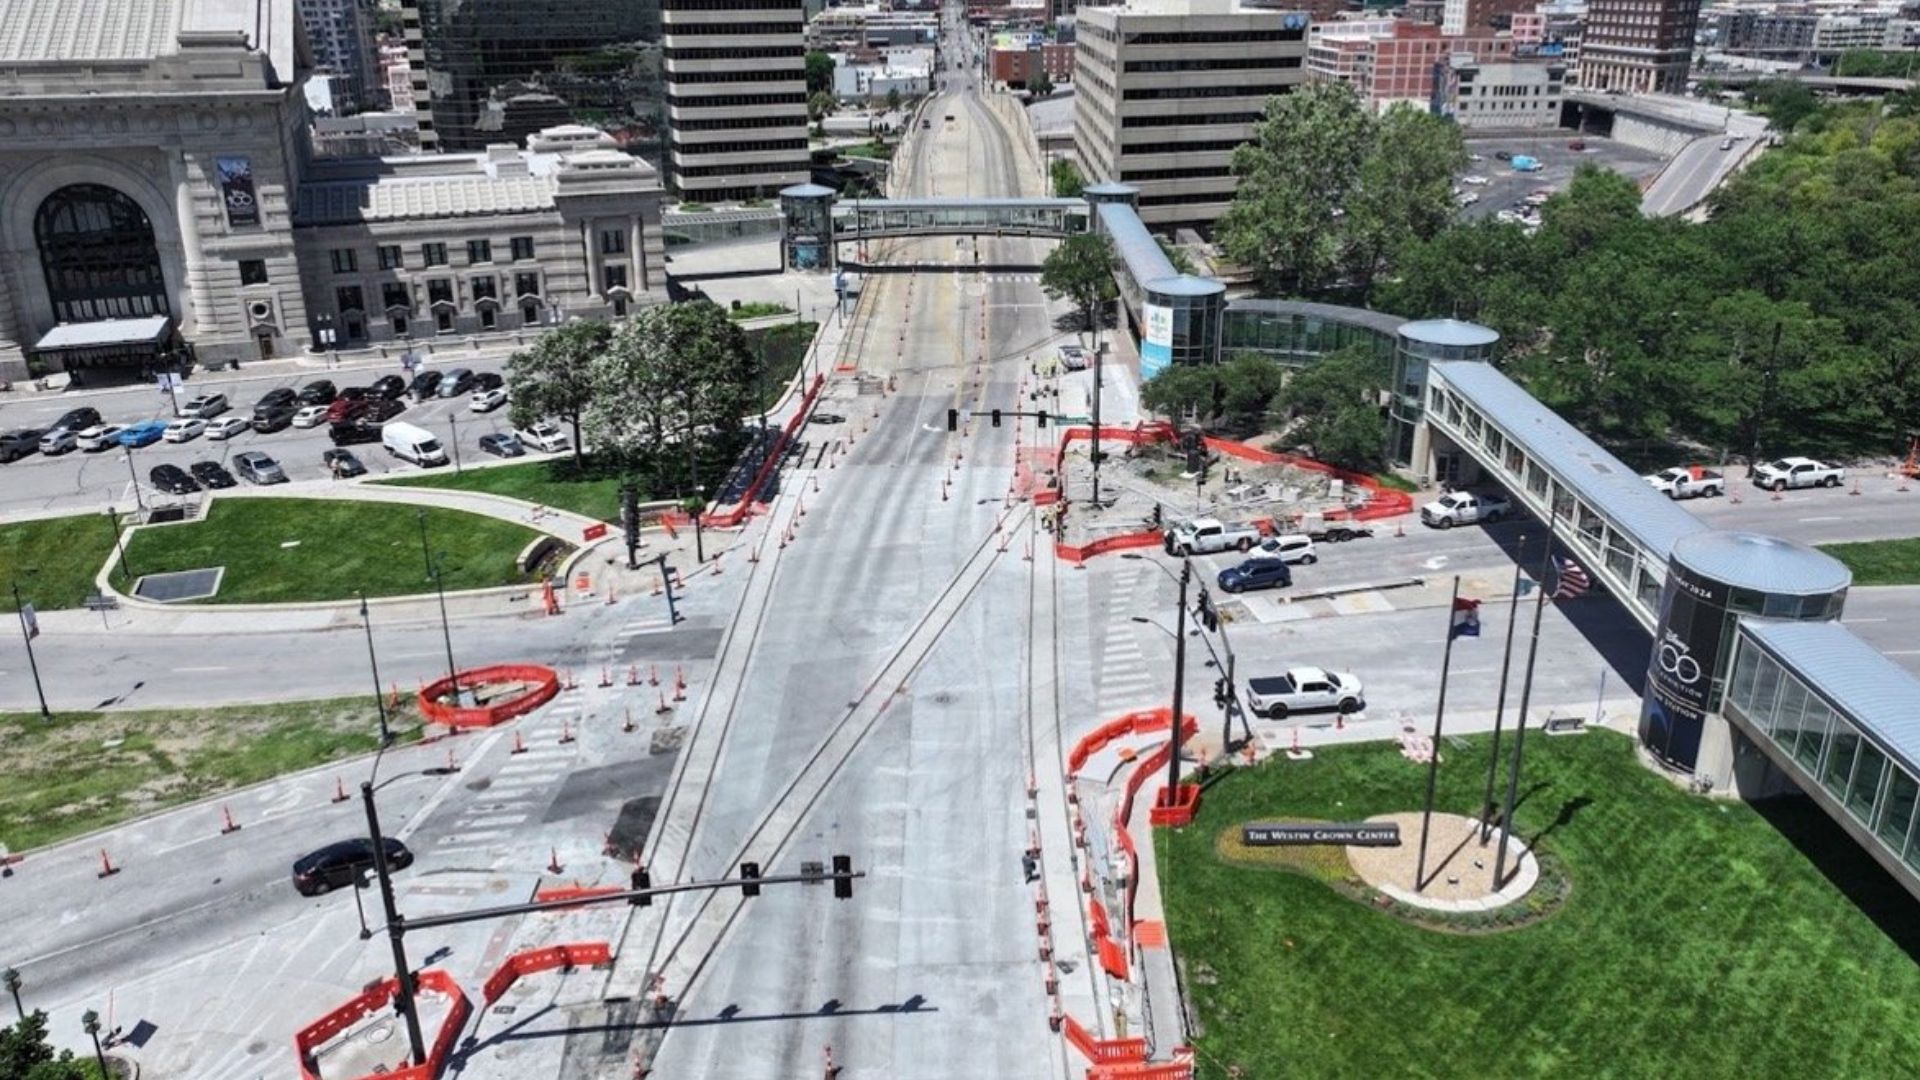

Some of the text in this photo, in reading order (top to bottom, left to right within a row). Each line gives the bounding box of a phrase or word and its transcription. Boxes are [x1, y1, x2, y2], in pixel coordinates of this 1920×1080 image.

[1249, 830, 1396, 840] THE WESTIN CROWN CENTER
